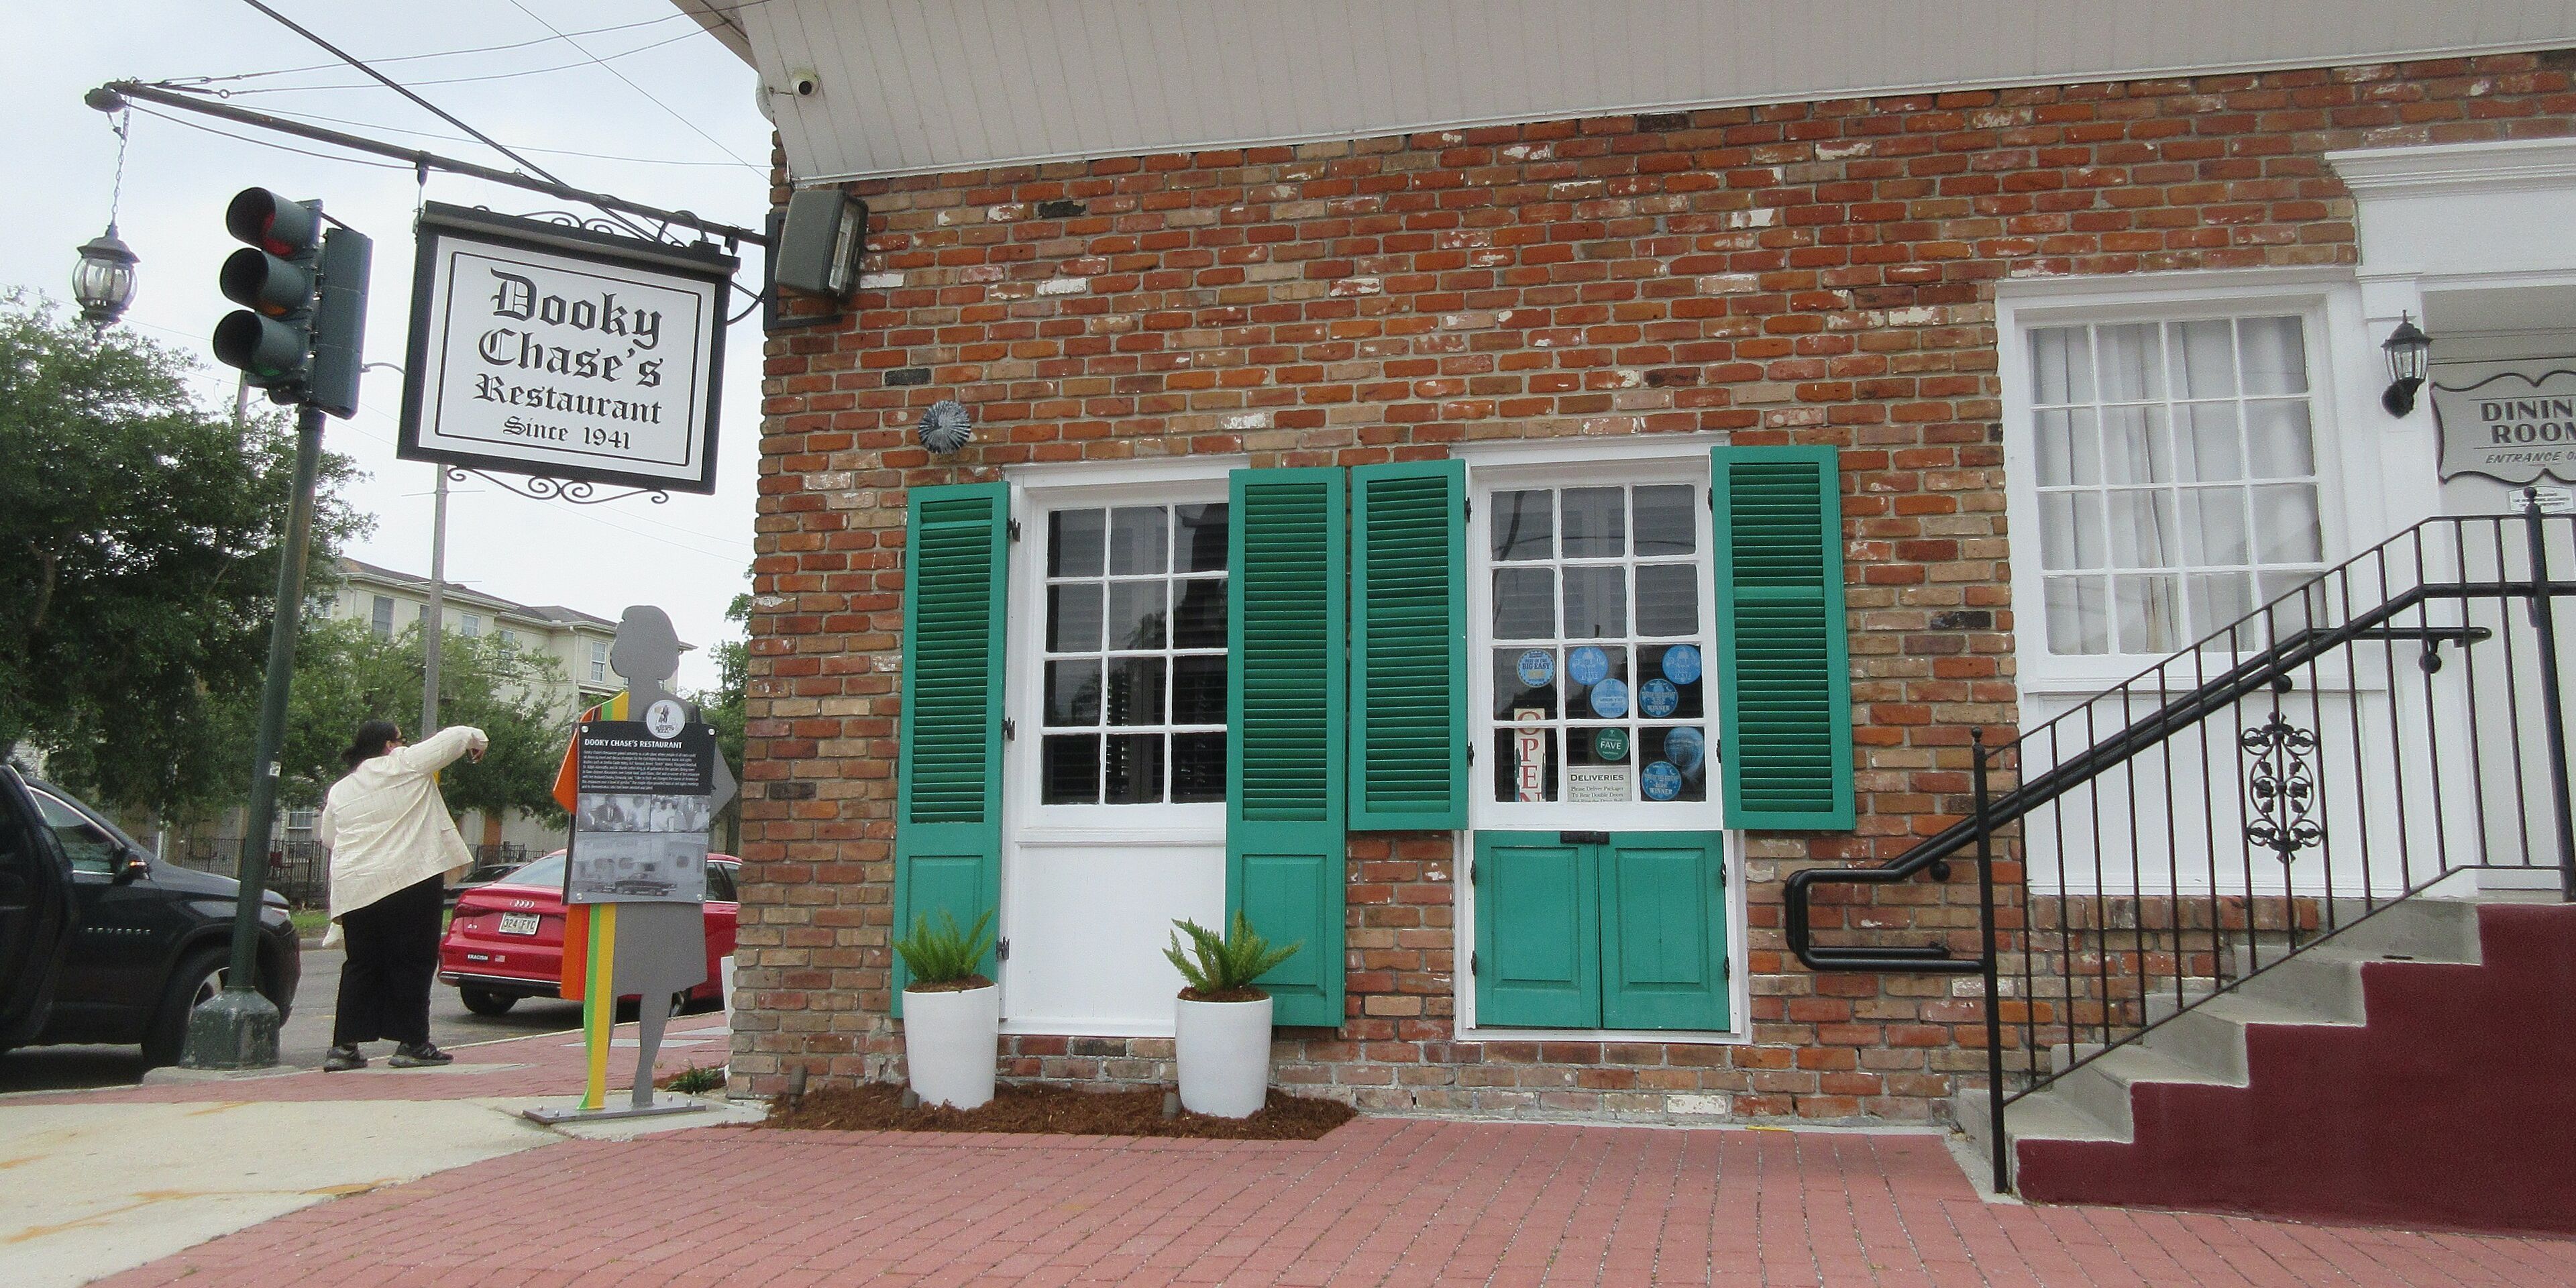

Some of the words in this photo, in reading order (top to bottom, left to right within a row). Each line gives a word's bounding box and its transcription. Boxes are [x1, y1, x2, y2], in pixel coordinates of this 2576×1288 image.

[490, 267, 663, 350] Dooky
[478, 327, 663, 388] Chase's
[472, 372, 662, 425] Restaurant
[502, 415, 568, 443] Since
[584, 426, 631, 450] 1941
[2485, 451, 2562, 464] ENTRANCE
[584, 739, 609, 747] DOOKY
[610, 739, 638, 747] CHASE'S
[639, 740, 683, 749] RESTAURANT
[1600, 741, 1621, 750] FAVE
[504, 919, 517, 928] 324
